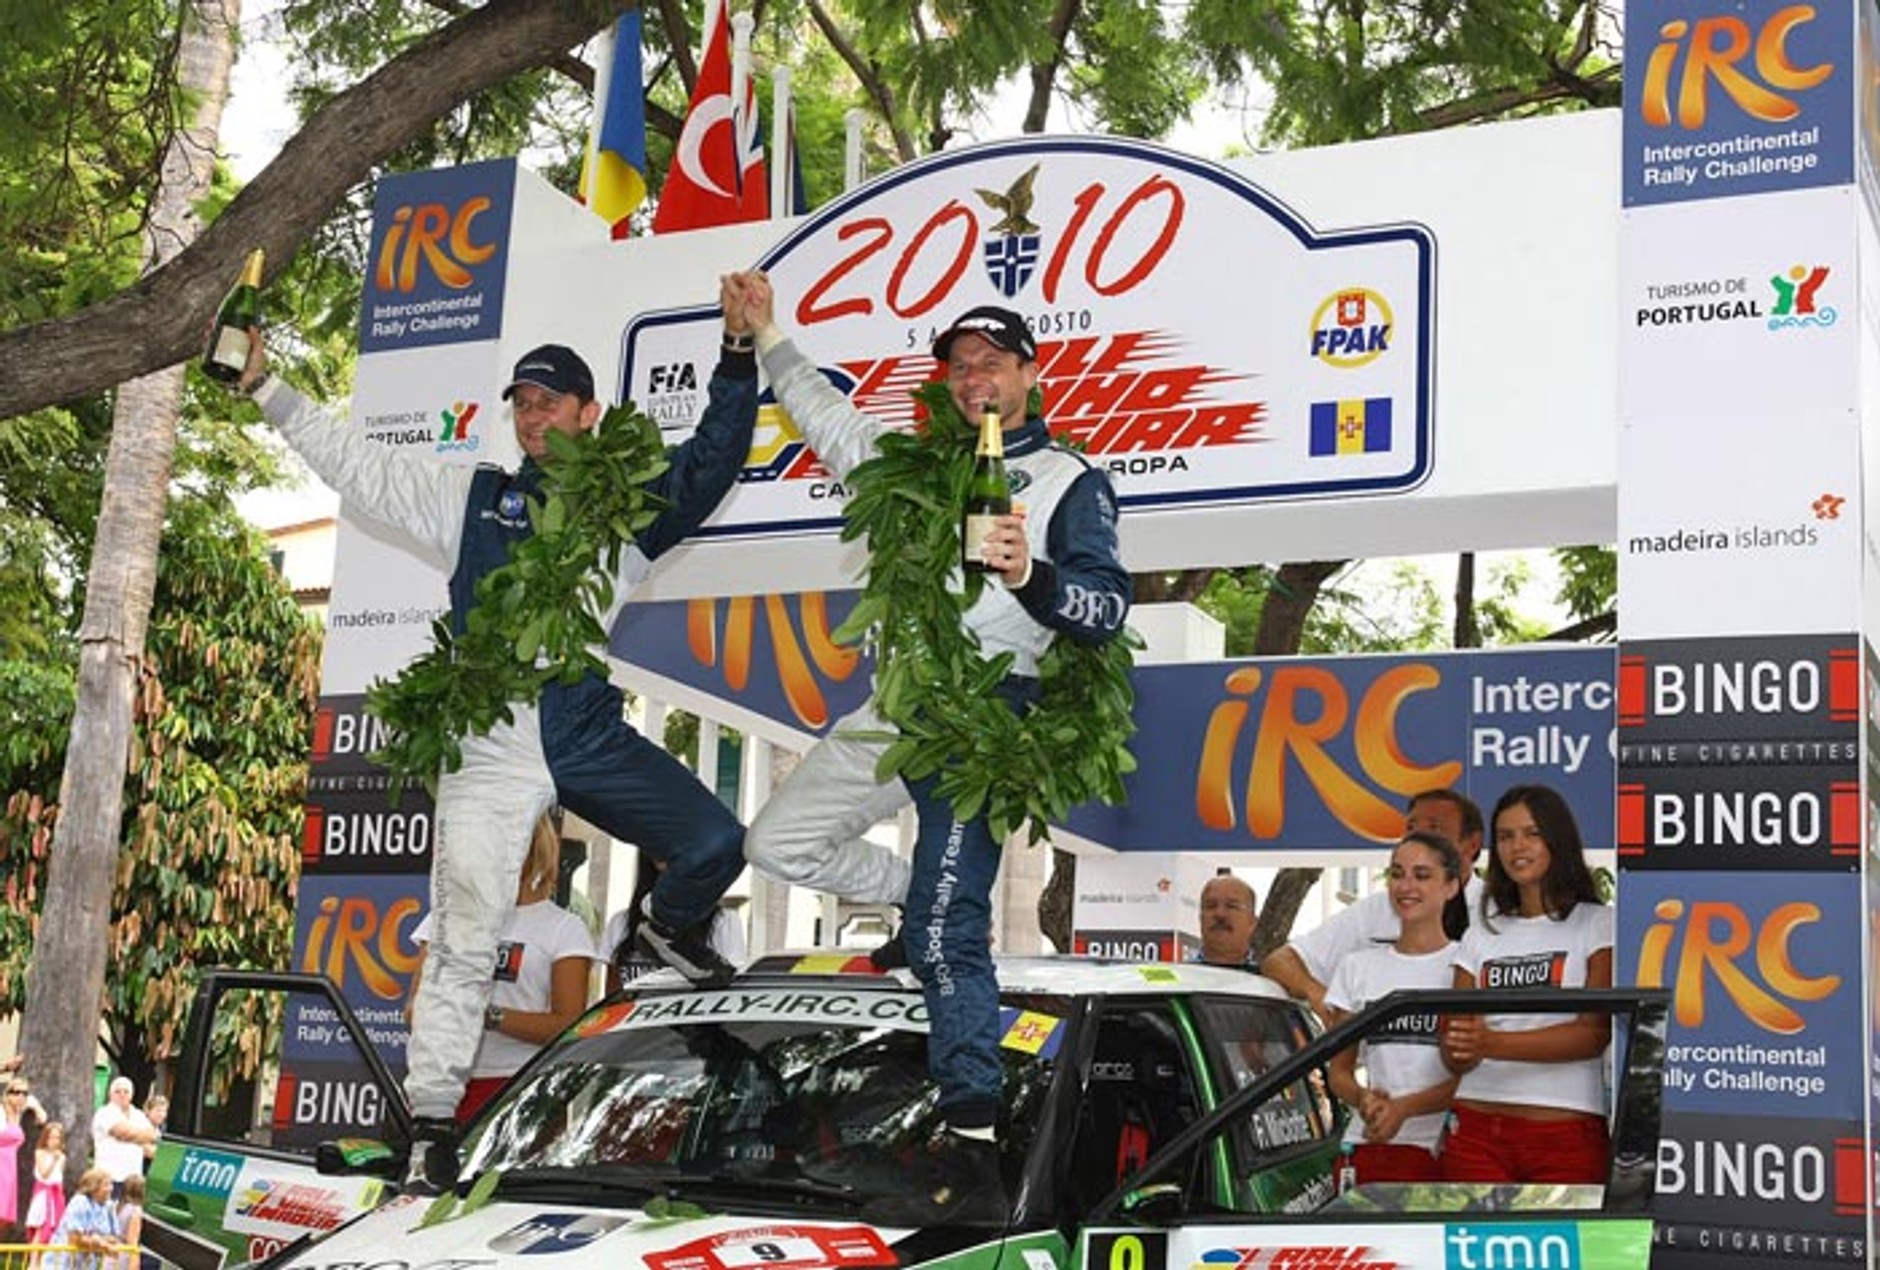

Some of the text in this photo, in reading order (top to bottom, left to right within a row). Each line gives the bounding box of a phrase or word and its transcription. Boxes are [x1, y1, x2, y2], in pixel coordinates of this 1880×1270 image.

[1642, 5, 1834, 129] iRC
[1644, 127, 1819, 163] Intercontinental
[1644, 153, 1818, 186] Rally Challenge
[375, 196, 496, 293] iRC
[1648, 278, 1747, 301] TURISMO DE
[373, 293, 482, 319] Intercontinental
[1637, 300, 1762, 326] PORTUGAL
[371, 312, 480, 338] Rally Challenge
[1025, 310, 1092, 335] GOSTO
[1311, 323, 1390, 357] FPAK
[365, 411, 427, 428] TURISMO DE
[1108, 455, 1189, 476] ROPA
[1630, 523, 1818, 554] madeira islands
[332, 606, 442, 628] madeira island
[1472, 676, 1617, 714] Interc
[1653, 659, 1820, 716] BINGO
[1196, 663, 1463, 844] iRC
[1472, 725, 1590, 773] Rally
[1620, 742, 1857, 762] FINE CIGARETTES
[324, 812, 429, 857] BINGO
[1653, 791, 1821, 846] BINGO
[303, 896, 421, 1000] iRC
[1088, 940, 1158, 961] BINGO
[1488, 961, 1549, 988] BINGO
[1636, 899, 1841, 1034] iRC
[297, 1025, 333, 1045] Rally
[1667, 1044, 1826, 1067] ercontinental
[1704, 1068, 1825, 1097] Challenge
[295, 1080, 387, 1127] BING
[181, 1151, 235, 1191] tmn
[1655, 1138, 1825, 1202] BINGO
[750, 1242, 787, 1262] 9
[1448, 1227, 1571, 1270] tmn
[1700, 1229, 1864, 1258] CIGARETTES
